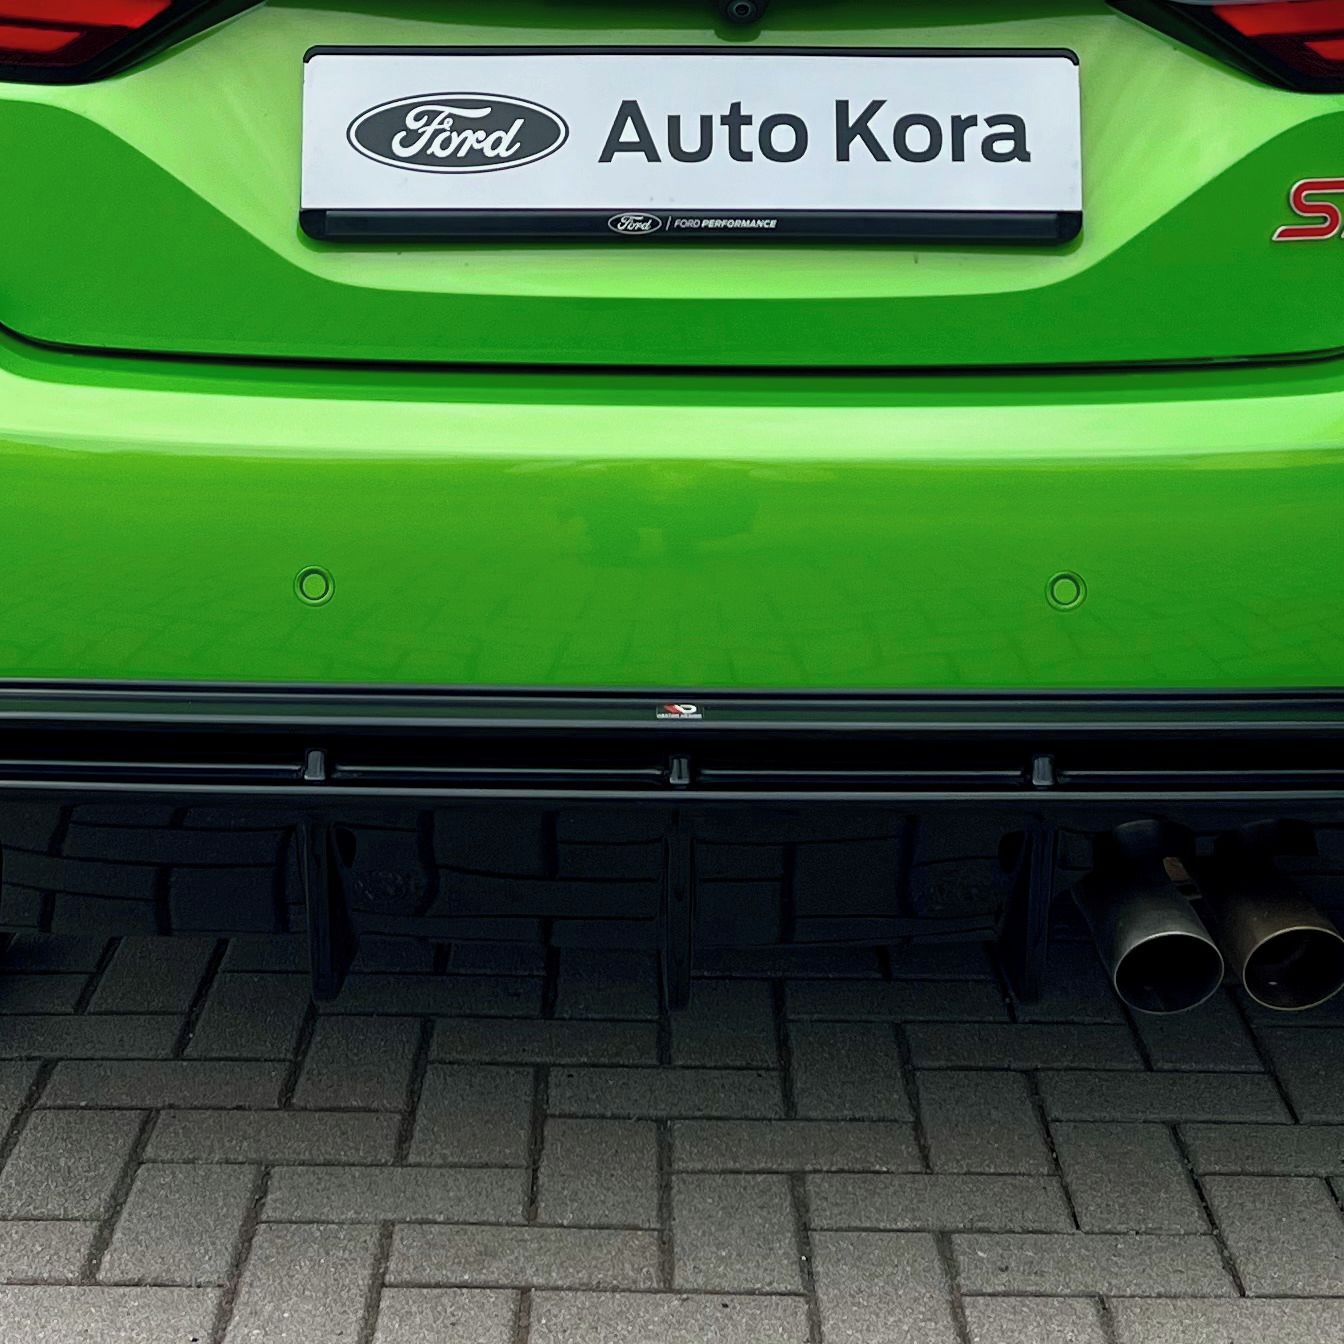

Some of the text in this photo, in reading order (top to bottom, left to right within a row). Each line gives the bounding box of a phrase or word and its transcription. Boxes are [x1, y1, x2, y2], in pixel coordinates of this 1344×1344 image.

[390, 99, 1032, 164] Ford Auto Kora
[616, 215, 777, 231] Ford FORD PERFORMANCE
